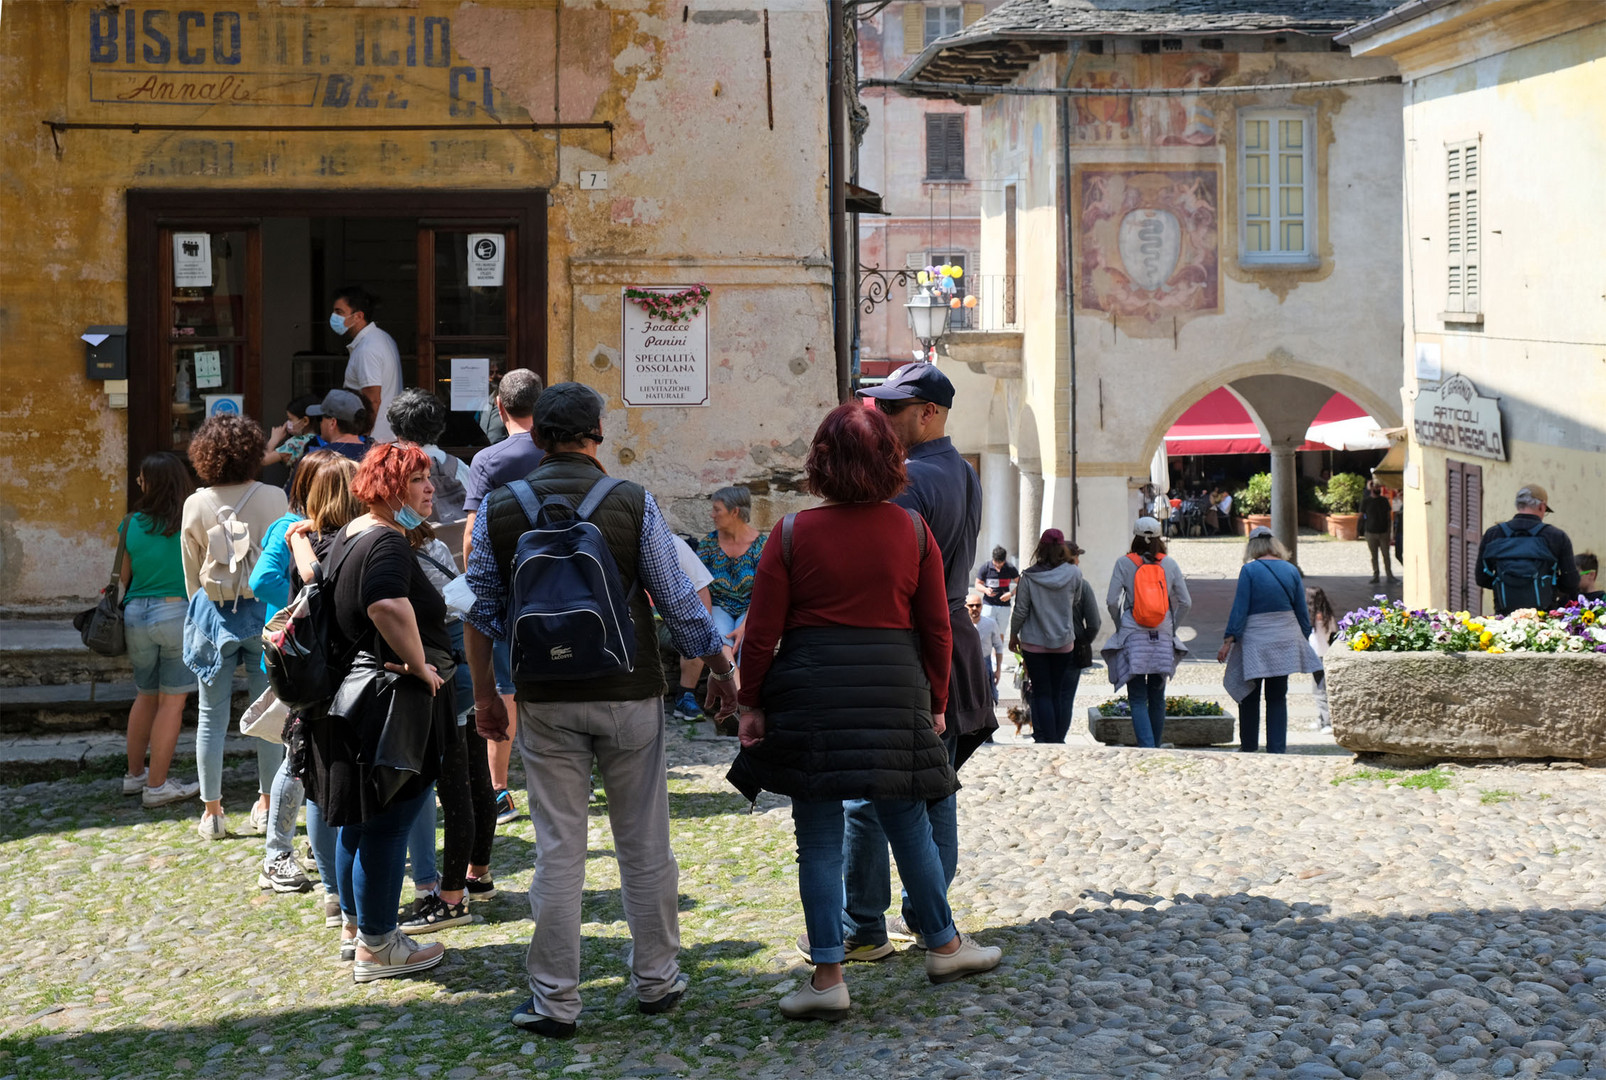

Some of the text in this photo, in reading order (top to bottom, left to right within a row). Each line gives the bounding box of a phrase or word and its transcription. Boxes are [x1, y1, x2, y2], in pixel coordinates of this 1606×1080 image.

[590, 173, 597, 187] 7
[641, 322, 689, 333] Focacce
[645, 336, 687, 347] Panini
[635, 352, 695, 362] SPECIALITÀ
[636, 364, 694, 372] OSSOLANA
[1434, 406, 1479, 424] ARTICOLI
